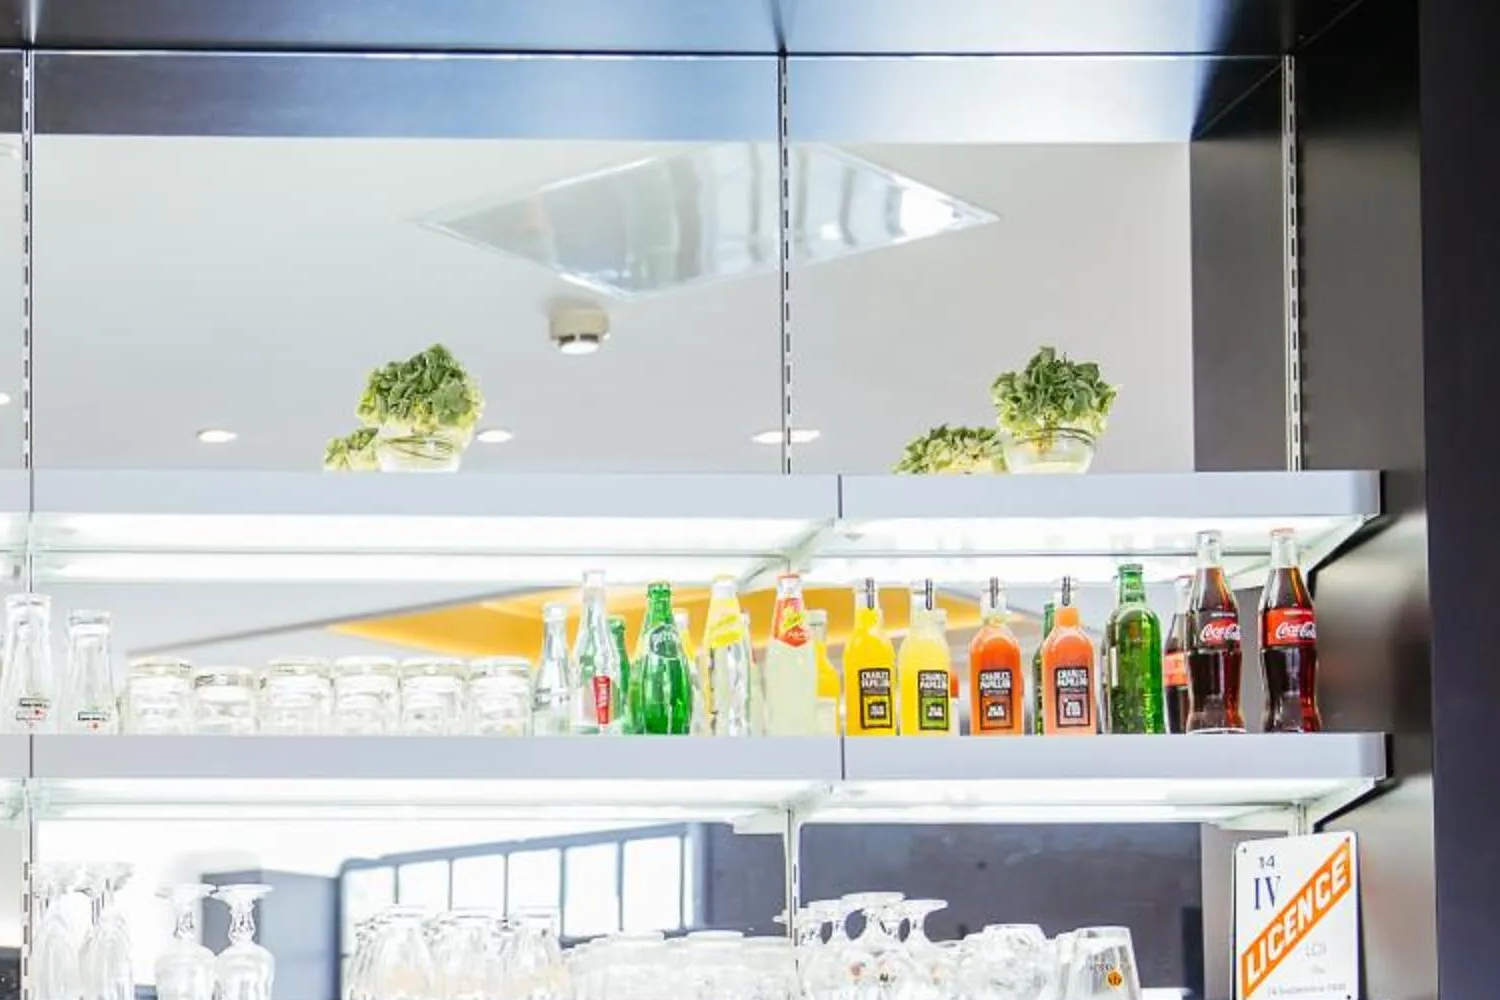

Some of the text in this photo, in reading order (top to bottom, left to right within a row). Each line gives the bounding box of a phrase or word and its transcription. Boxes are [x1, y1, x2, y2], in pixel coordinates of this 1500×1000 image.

[1259, 855, 1275, 868] 14
[1255, 876, 1281, 910] IV
[1247, 850, 1348, 986] LICENCE
